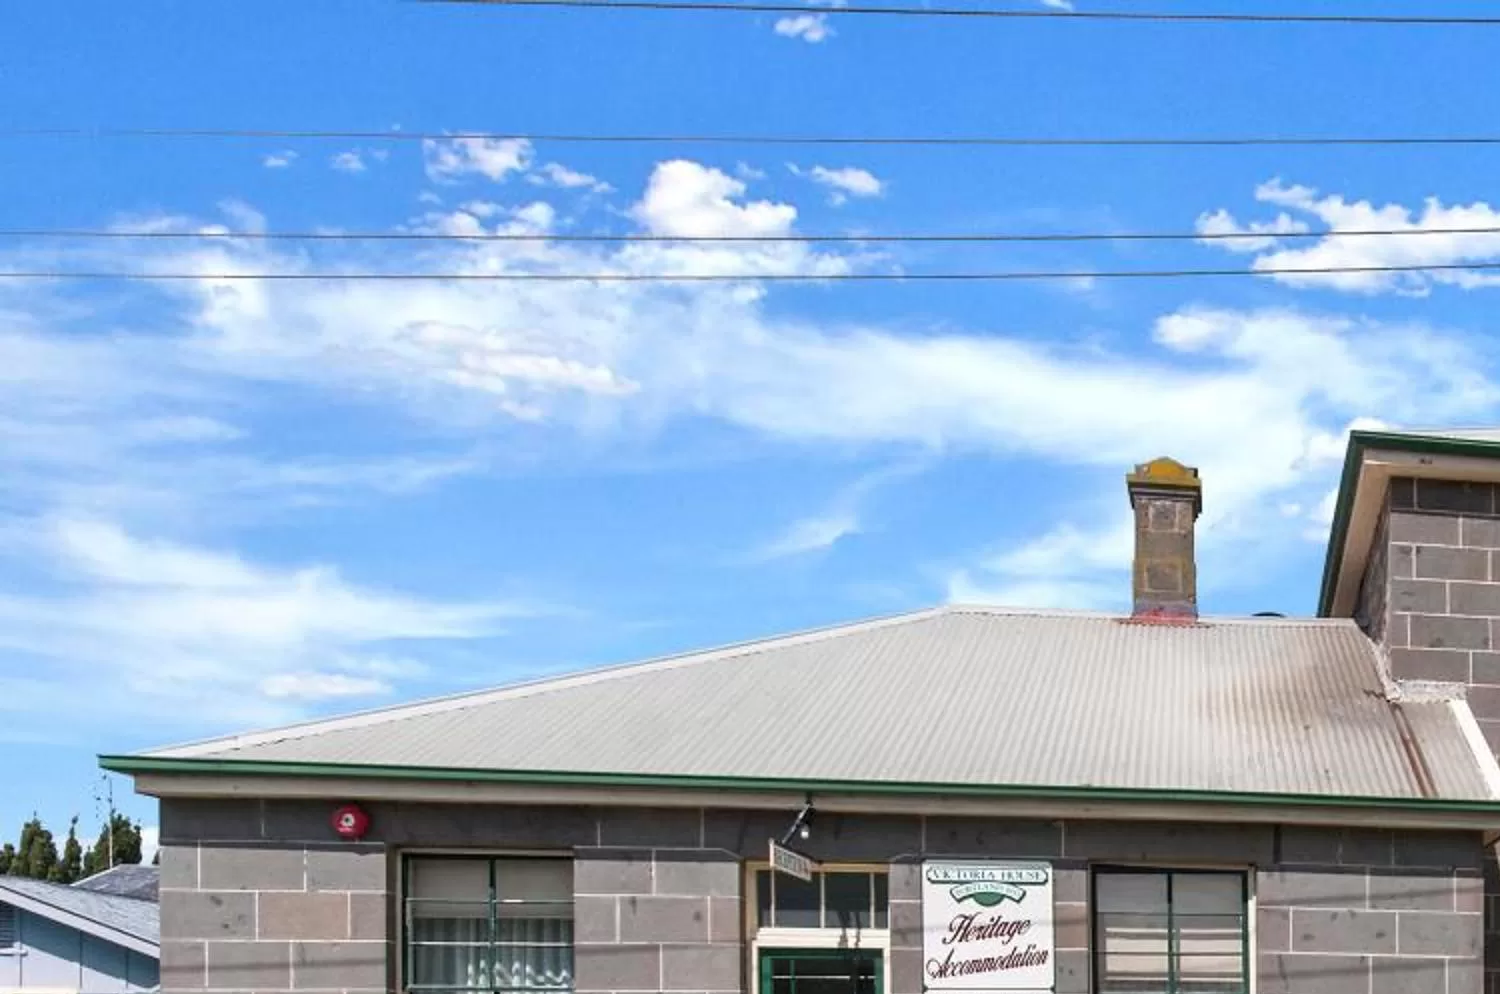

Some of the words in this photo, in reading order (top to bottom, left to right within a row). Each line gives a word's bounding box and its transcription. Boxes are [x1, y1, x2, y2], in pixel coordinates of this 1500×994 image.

[1001, 870, 1040, 880] HOUSE
[942, 911, 1031, 945] Heritage
[926, 944, 1049, 979] Accommodation
